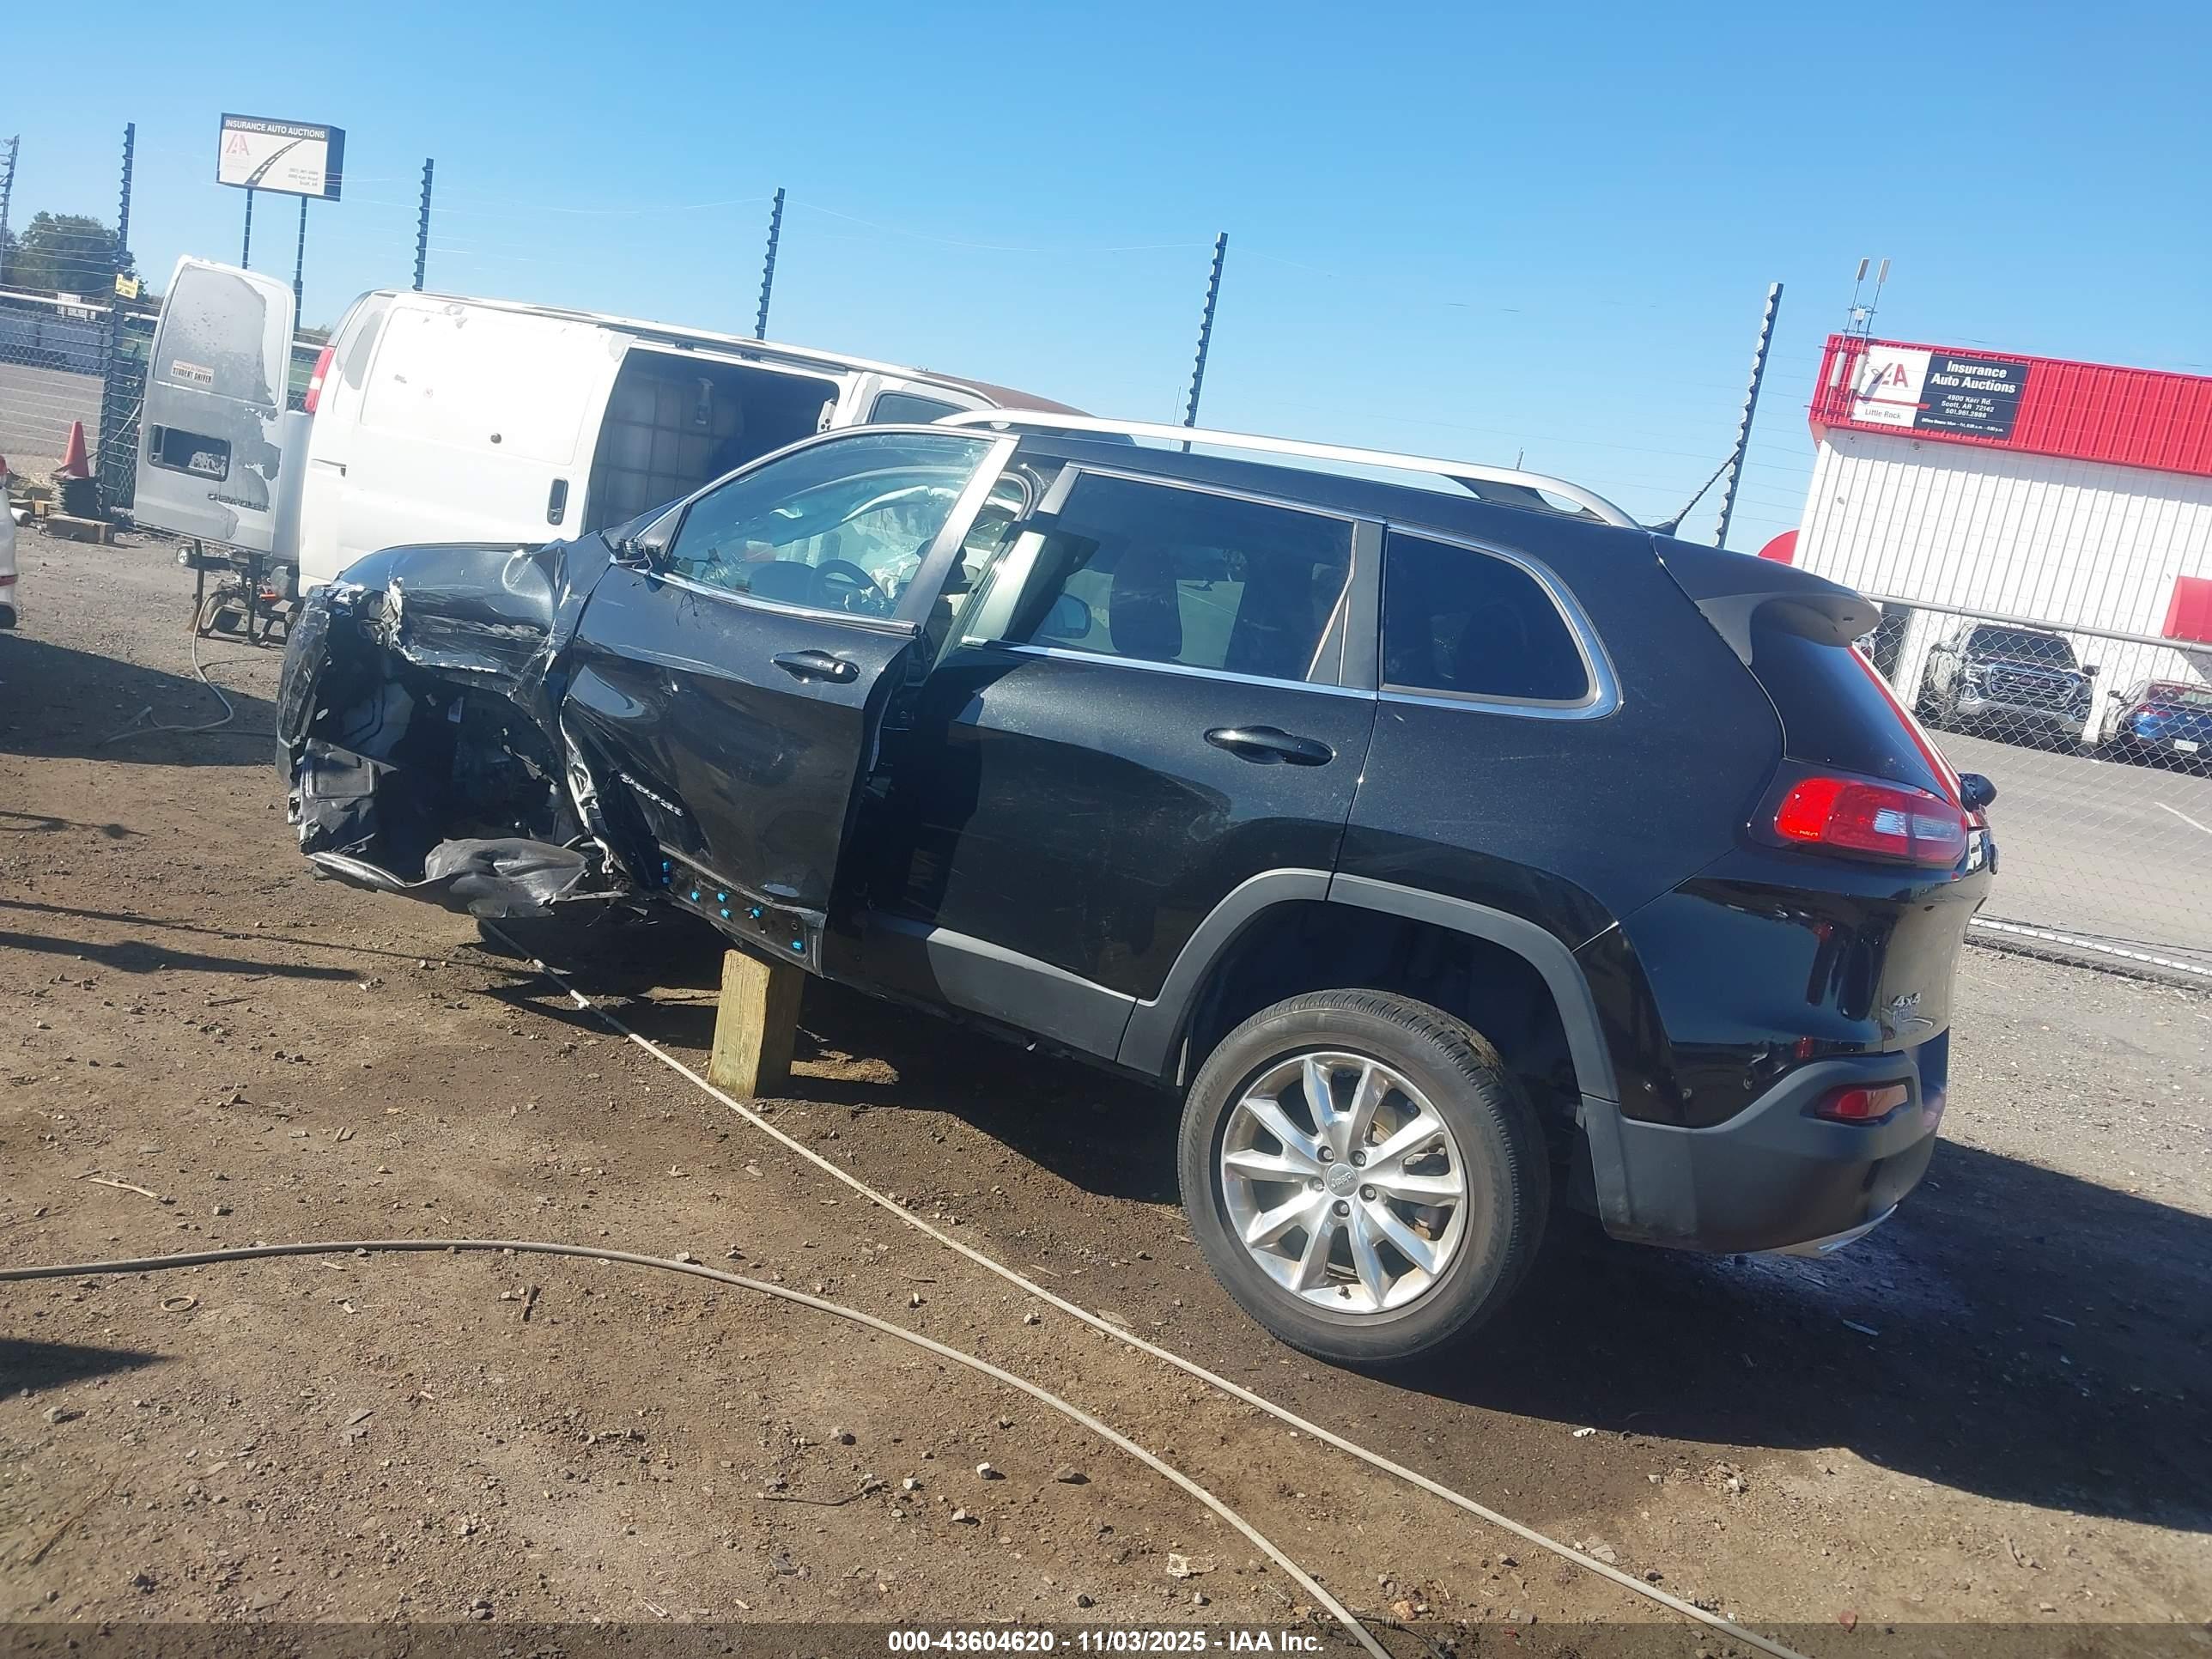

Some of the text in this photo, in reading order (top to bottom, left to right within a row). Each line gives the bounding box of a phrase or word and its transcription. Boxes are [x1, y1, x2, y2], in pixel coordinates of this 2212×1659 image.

[225, 119, 325, 138] INSURANCE AUTO AUCTIONS
[173, 367, 193, 379] STUDENT
[194, 372, 211, 383] DRIVER
[1946, 360, 2008, 379] Insurance
[1930, 373, 2017, 394] Auto Auctions
[1864, 408, 1901, 420] Little Rock
[1941, 400, 1960, 410] Scott,
[1975, 404, 1995, 413] 72142
[207, 493, 270, 513] CHEVROLET
[1893, 993, 1921, 1007] 4x4
[1329, 1171, 1354, 1188] Jeep
